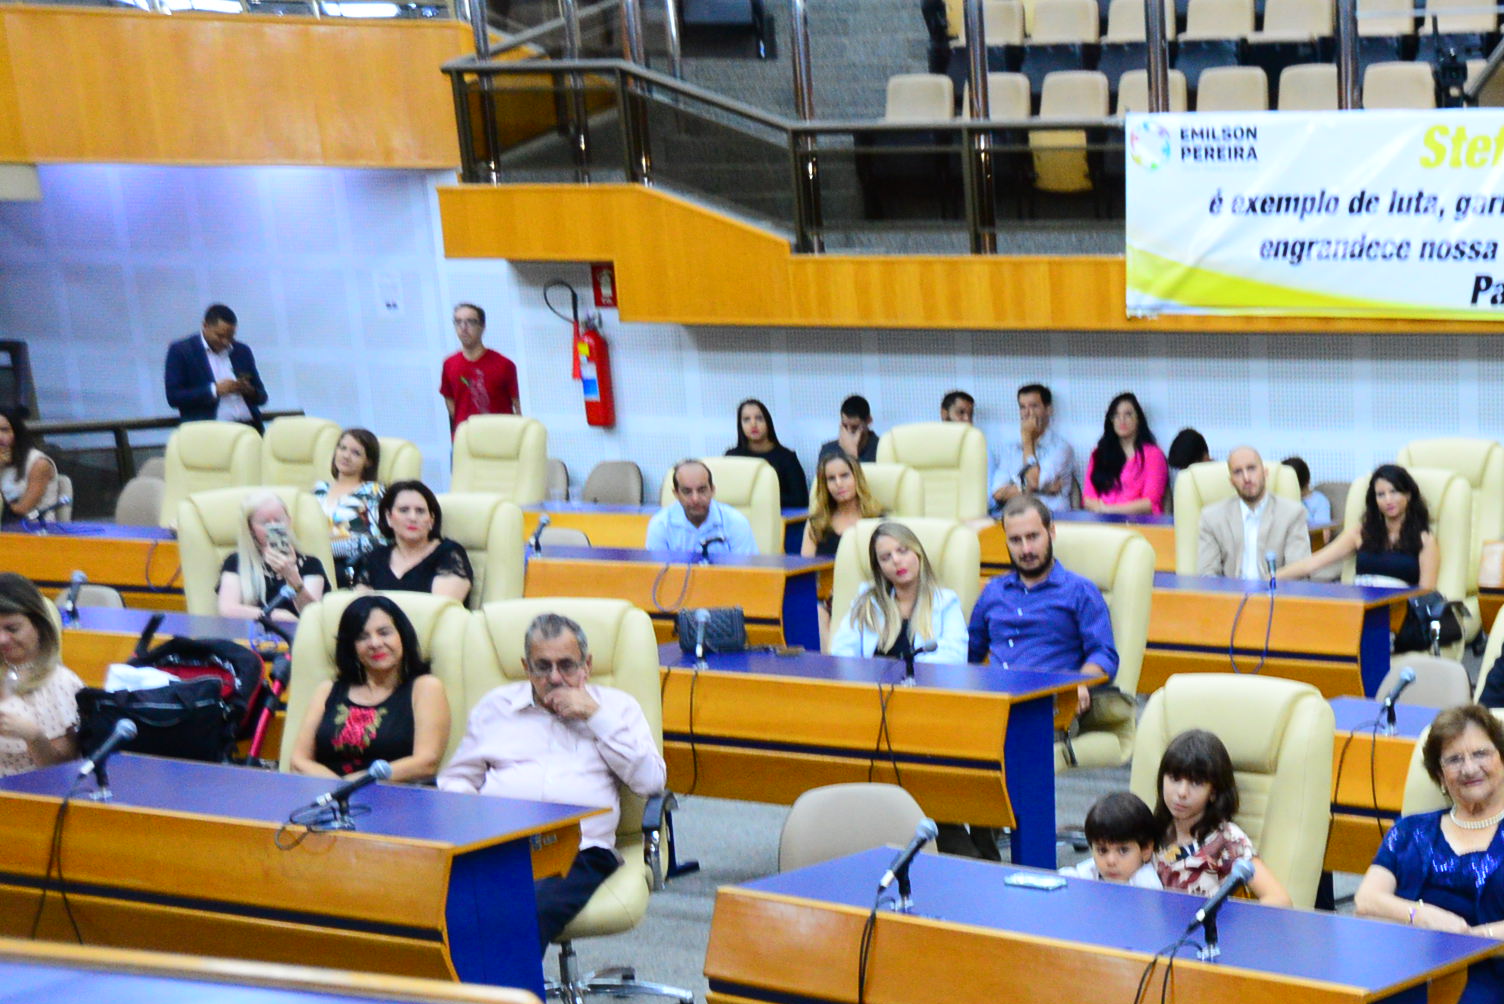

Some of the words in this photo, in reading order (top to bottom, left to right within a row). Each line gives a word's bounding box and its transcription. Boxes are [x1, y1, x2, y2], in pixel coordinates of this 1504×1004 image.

[1180, 126, 1258, 141] EMILSON
[1180, 145, 1258, 162] PEREIRA
[1209, 189, 1223, 215] é
[1231, 190, 1339, 219] exemplo
[1348, 190, 1380, 214] de
[1389, 190, 1444, 220] luta,
[1260, 234, 1411, 264] engrandece
[1419, 241, 1498, 260] nossa
